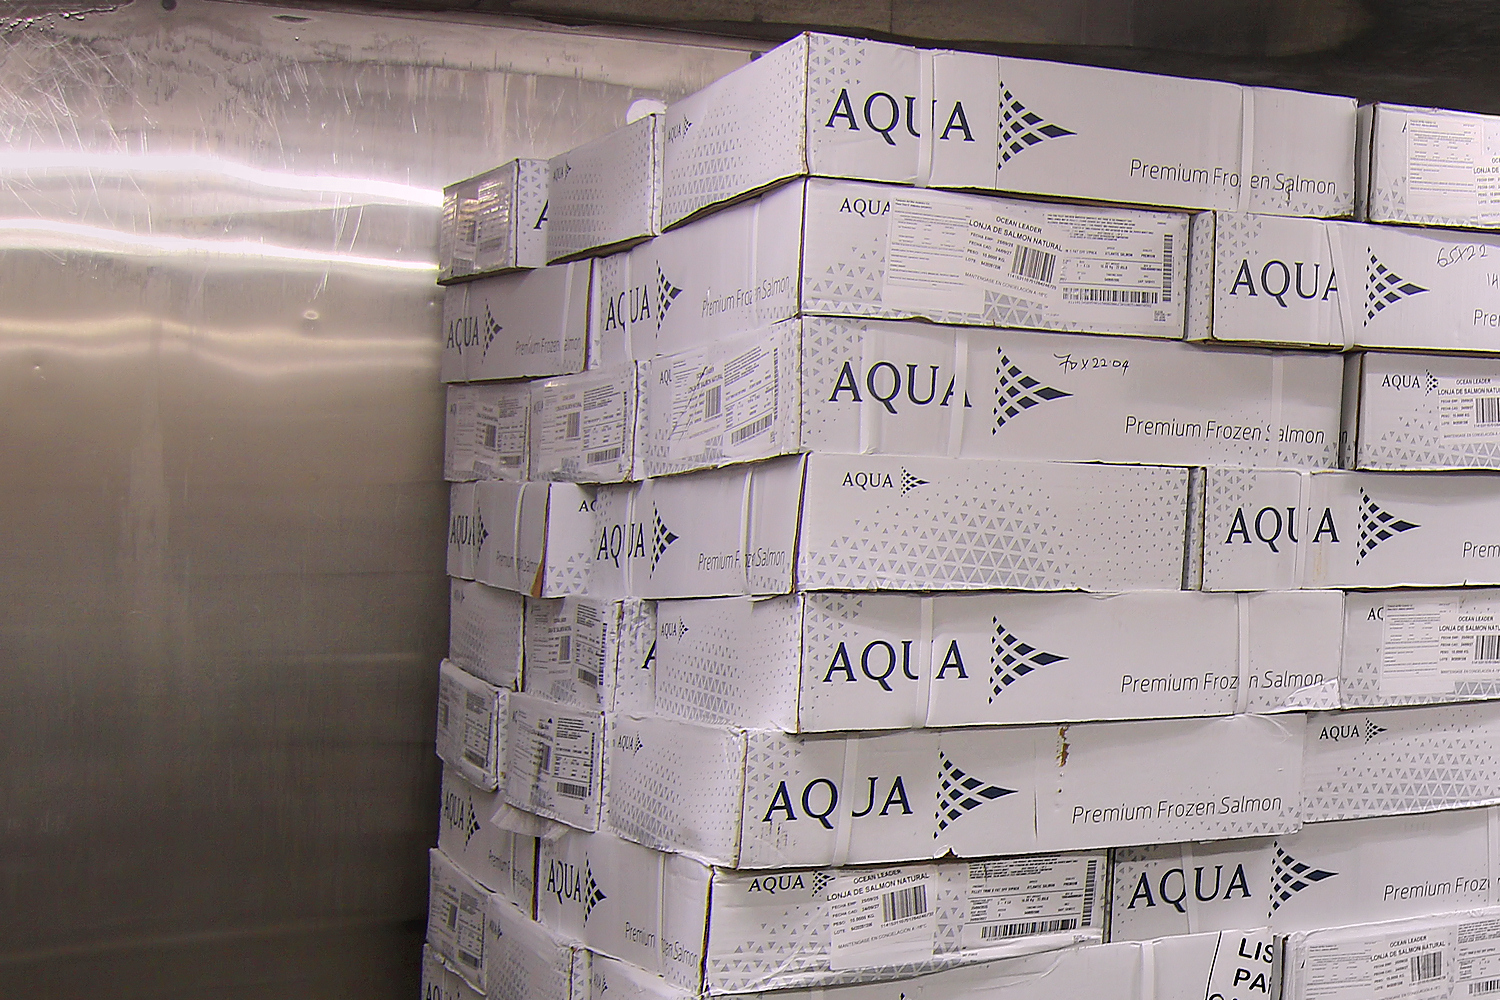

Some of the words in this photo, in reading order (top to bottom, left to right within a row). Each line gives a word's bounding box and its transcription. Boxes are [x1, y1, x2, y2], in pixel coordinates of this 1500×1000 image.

[825, 89, 974, 145] AQUA
[1130, 159, 1209, 184] Premium
[1212, 170, 1270, 191] Froen
[1275, 173, 1336, 195] Salmon
[969, 220, 992, 234] LONJA
[993, 228, 1002, 236] DE
[1004, 229, 1031, 244] SALMON
[1033, 236, 1063, 252] NATURAL
[996, 216, 1016, 227] OCEAN
[1018, 221, 1042, 234] LEADER
[1229, 259, 1342, 307] AQUA
[829, 361, 972, 415] AQUA
[1382, 374, 1421, 390] AQUA
[1438, 387, 1456, 395] LONJA
[1125, 415, 1201, 438] Premium
[1205, 419, 1262, 442] Frozen
[842, 472, 894, 489] AQUA
[1225, 507, 1340, 552] AQUA
[823, 640, 969, 692] AQUA
[1319, 724, 1360, 741] AQUA
[1071, 803, 1152, 825] Premium
[1156, 800, 1215, 820] Frozen
[1220, 795, 1282, 815] Salmon
[748, 874, 805, 893] AQUA
[826, 889, 850, 902] LONJA
[852, 886, 864, 895] DE
[865, 880, 896, 893] SALMON
[897, 872, 930, 886] NATURAL
[853, 874, 876, 885] OCEAN
[877, 869, 902, 880] LEADER
[1128, 863, 1251, 912] AQUA
[1233, 969, 1271, 994] PA
